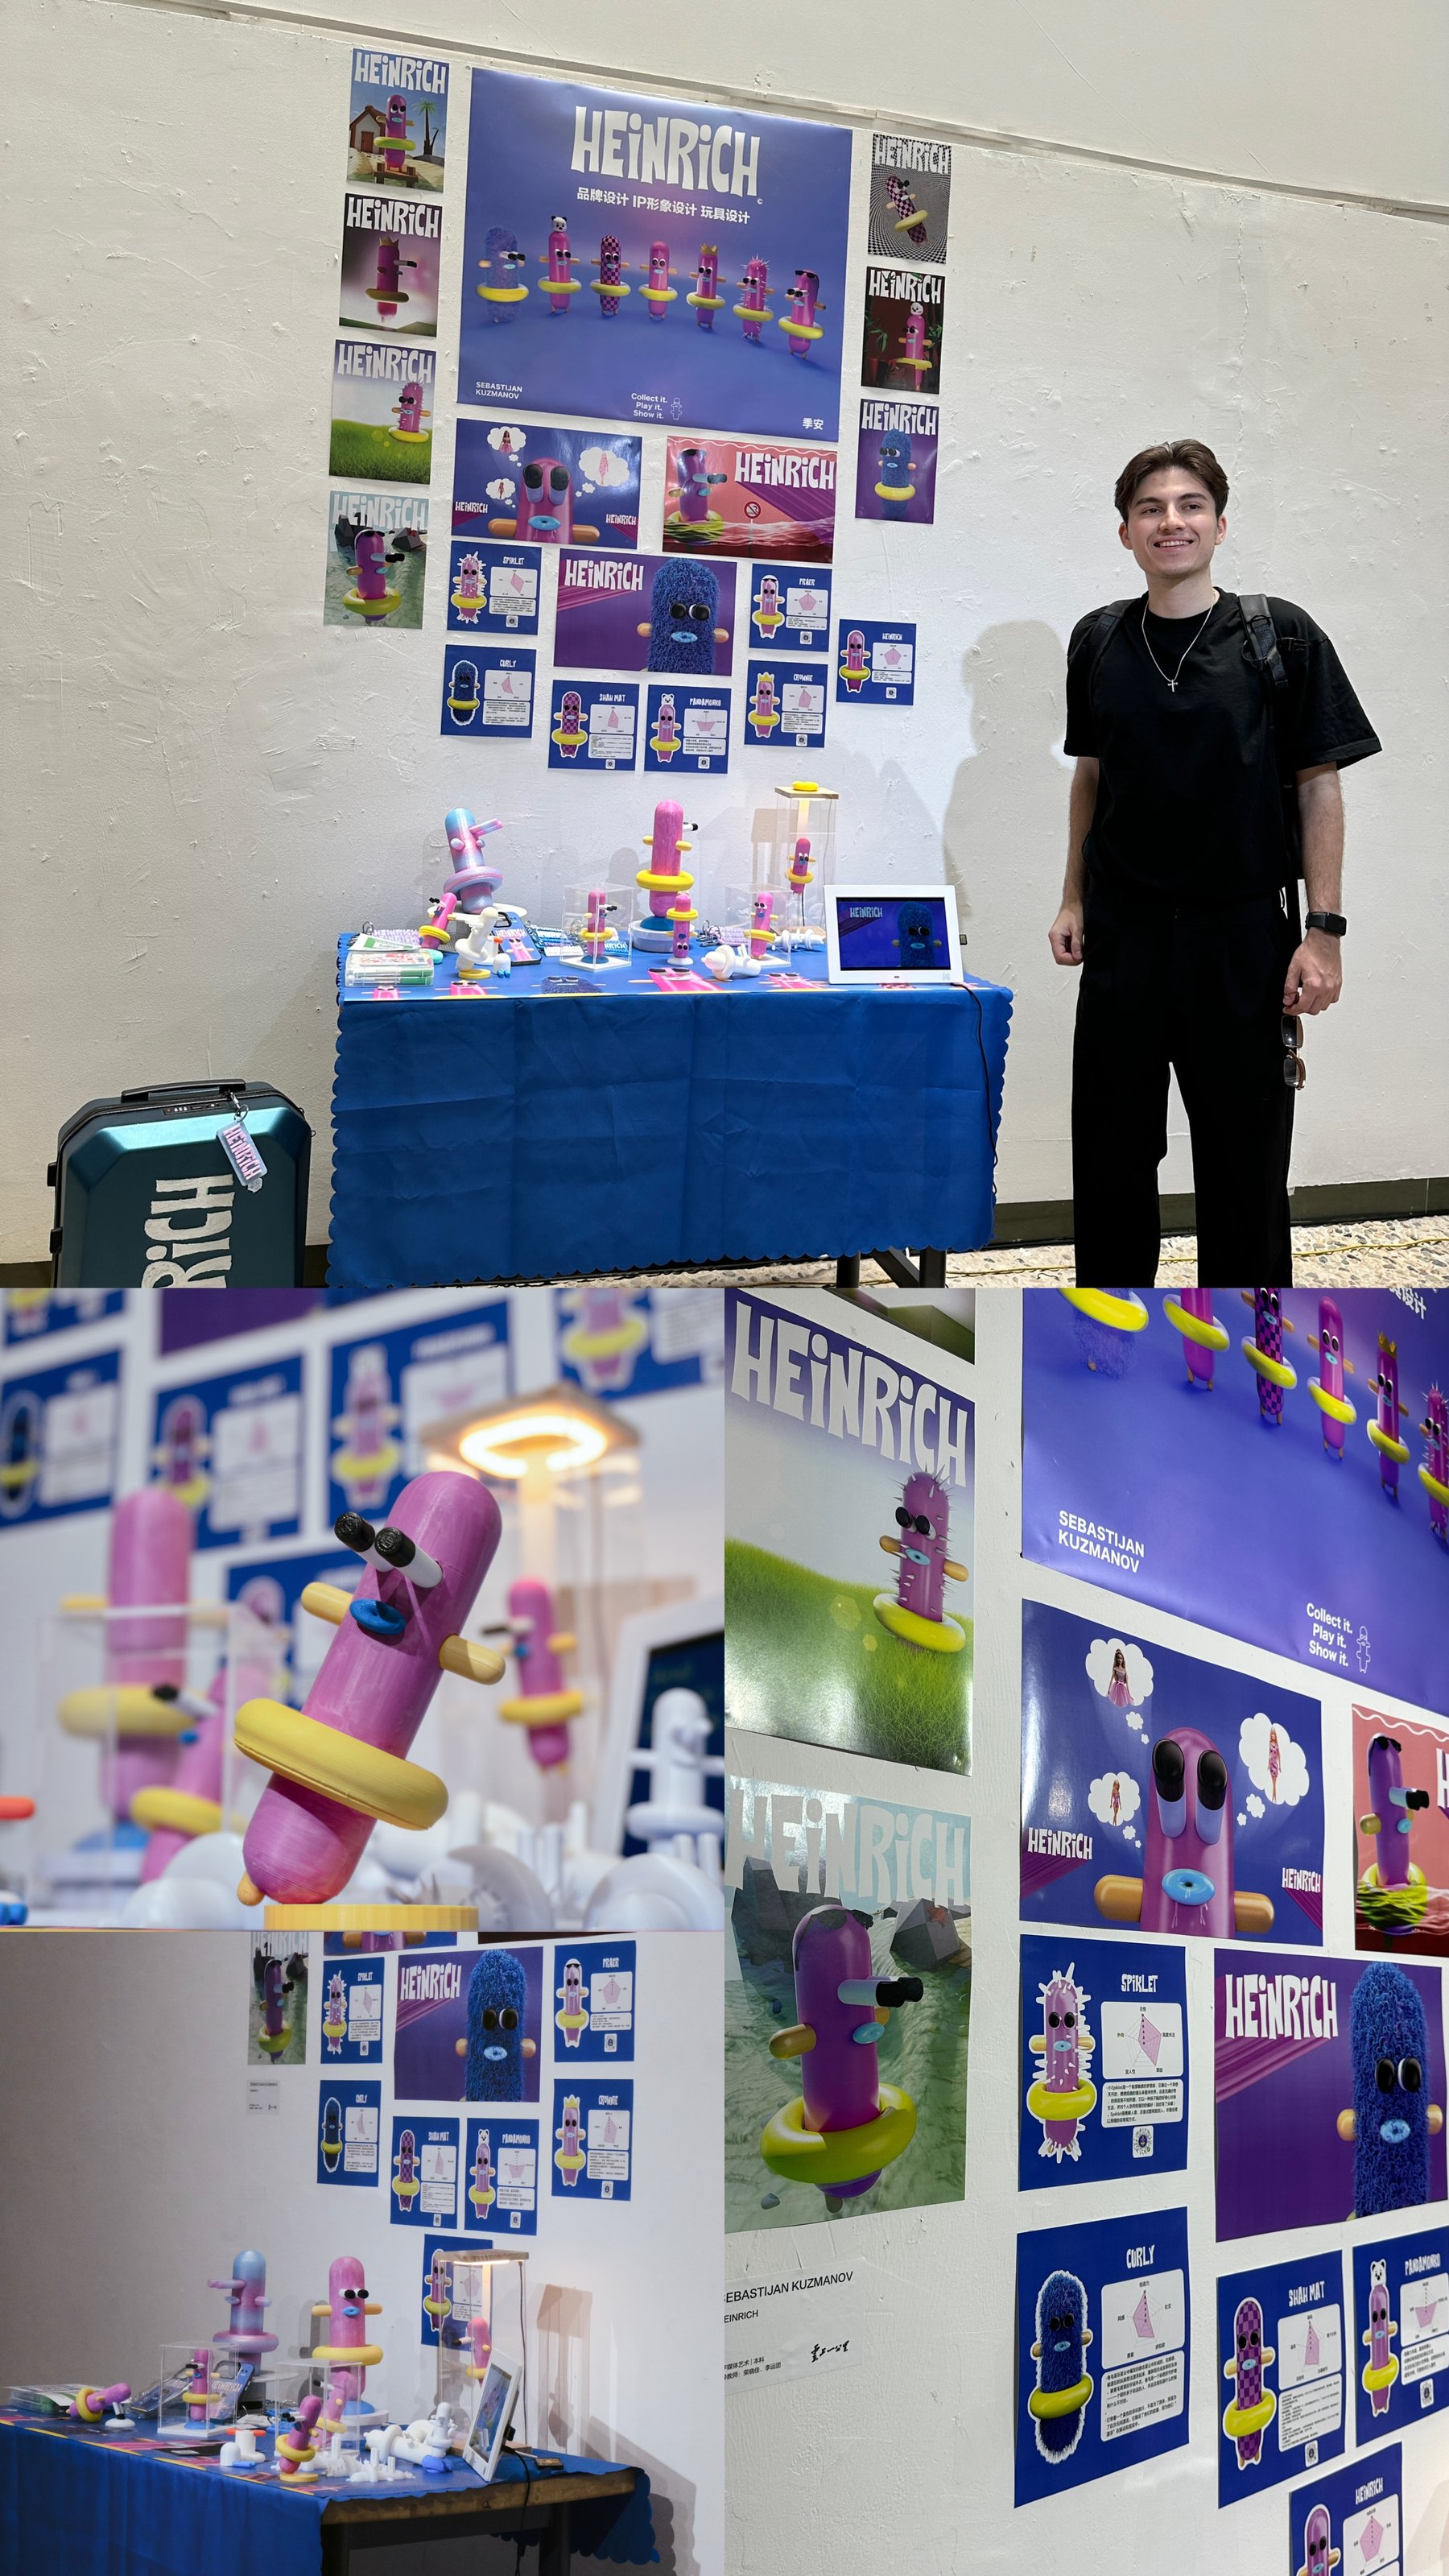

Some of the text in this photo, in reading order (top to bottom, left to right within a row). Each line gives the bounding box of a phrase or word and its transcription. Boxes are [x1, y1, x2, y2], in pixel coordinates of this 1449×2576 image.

[576, 187, 750, 224] 品牌设计 IP形象设计 玩具设计
[476, 382, 522, 392] SEBASTIJAN
[476, 389, 519, 399] KUZMANOV
[631, 393, 668, 403] Collect it.
[633, 409, 654, 419] Show
[636, 402, 653, 411] Play
[803, 418, 824, 431] 季安
[499, 660, 516, 668] CURLY
[614, 694, 626, 703] MAT
[1059, 1510, 1145, 1558] SEBASTIJAN
[1058, 1528, 1140, 1573] KUZMANOV
[1307, 1602, 1352, 1635] Collect it.
[1313, 1623, 1347, 1648] Play it.
[1309, 1639, 1348, 1668] Show it.
[1126, 2244, 1155, 2269] CURLY
[724, 2271, 853, 2304] EBASTIJAN KUZMANOV
[1288, 2280, 1325, 2307] SHAH MAT
